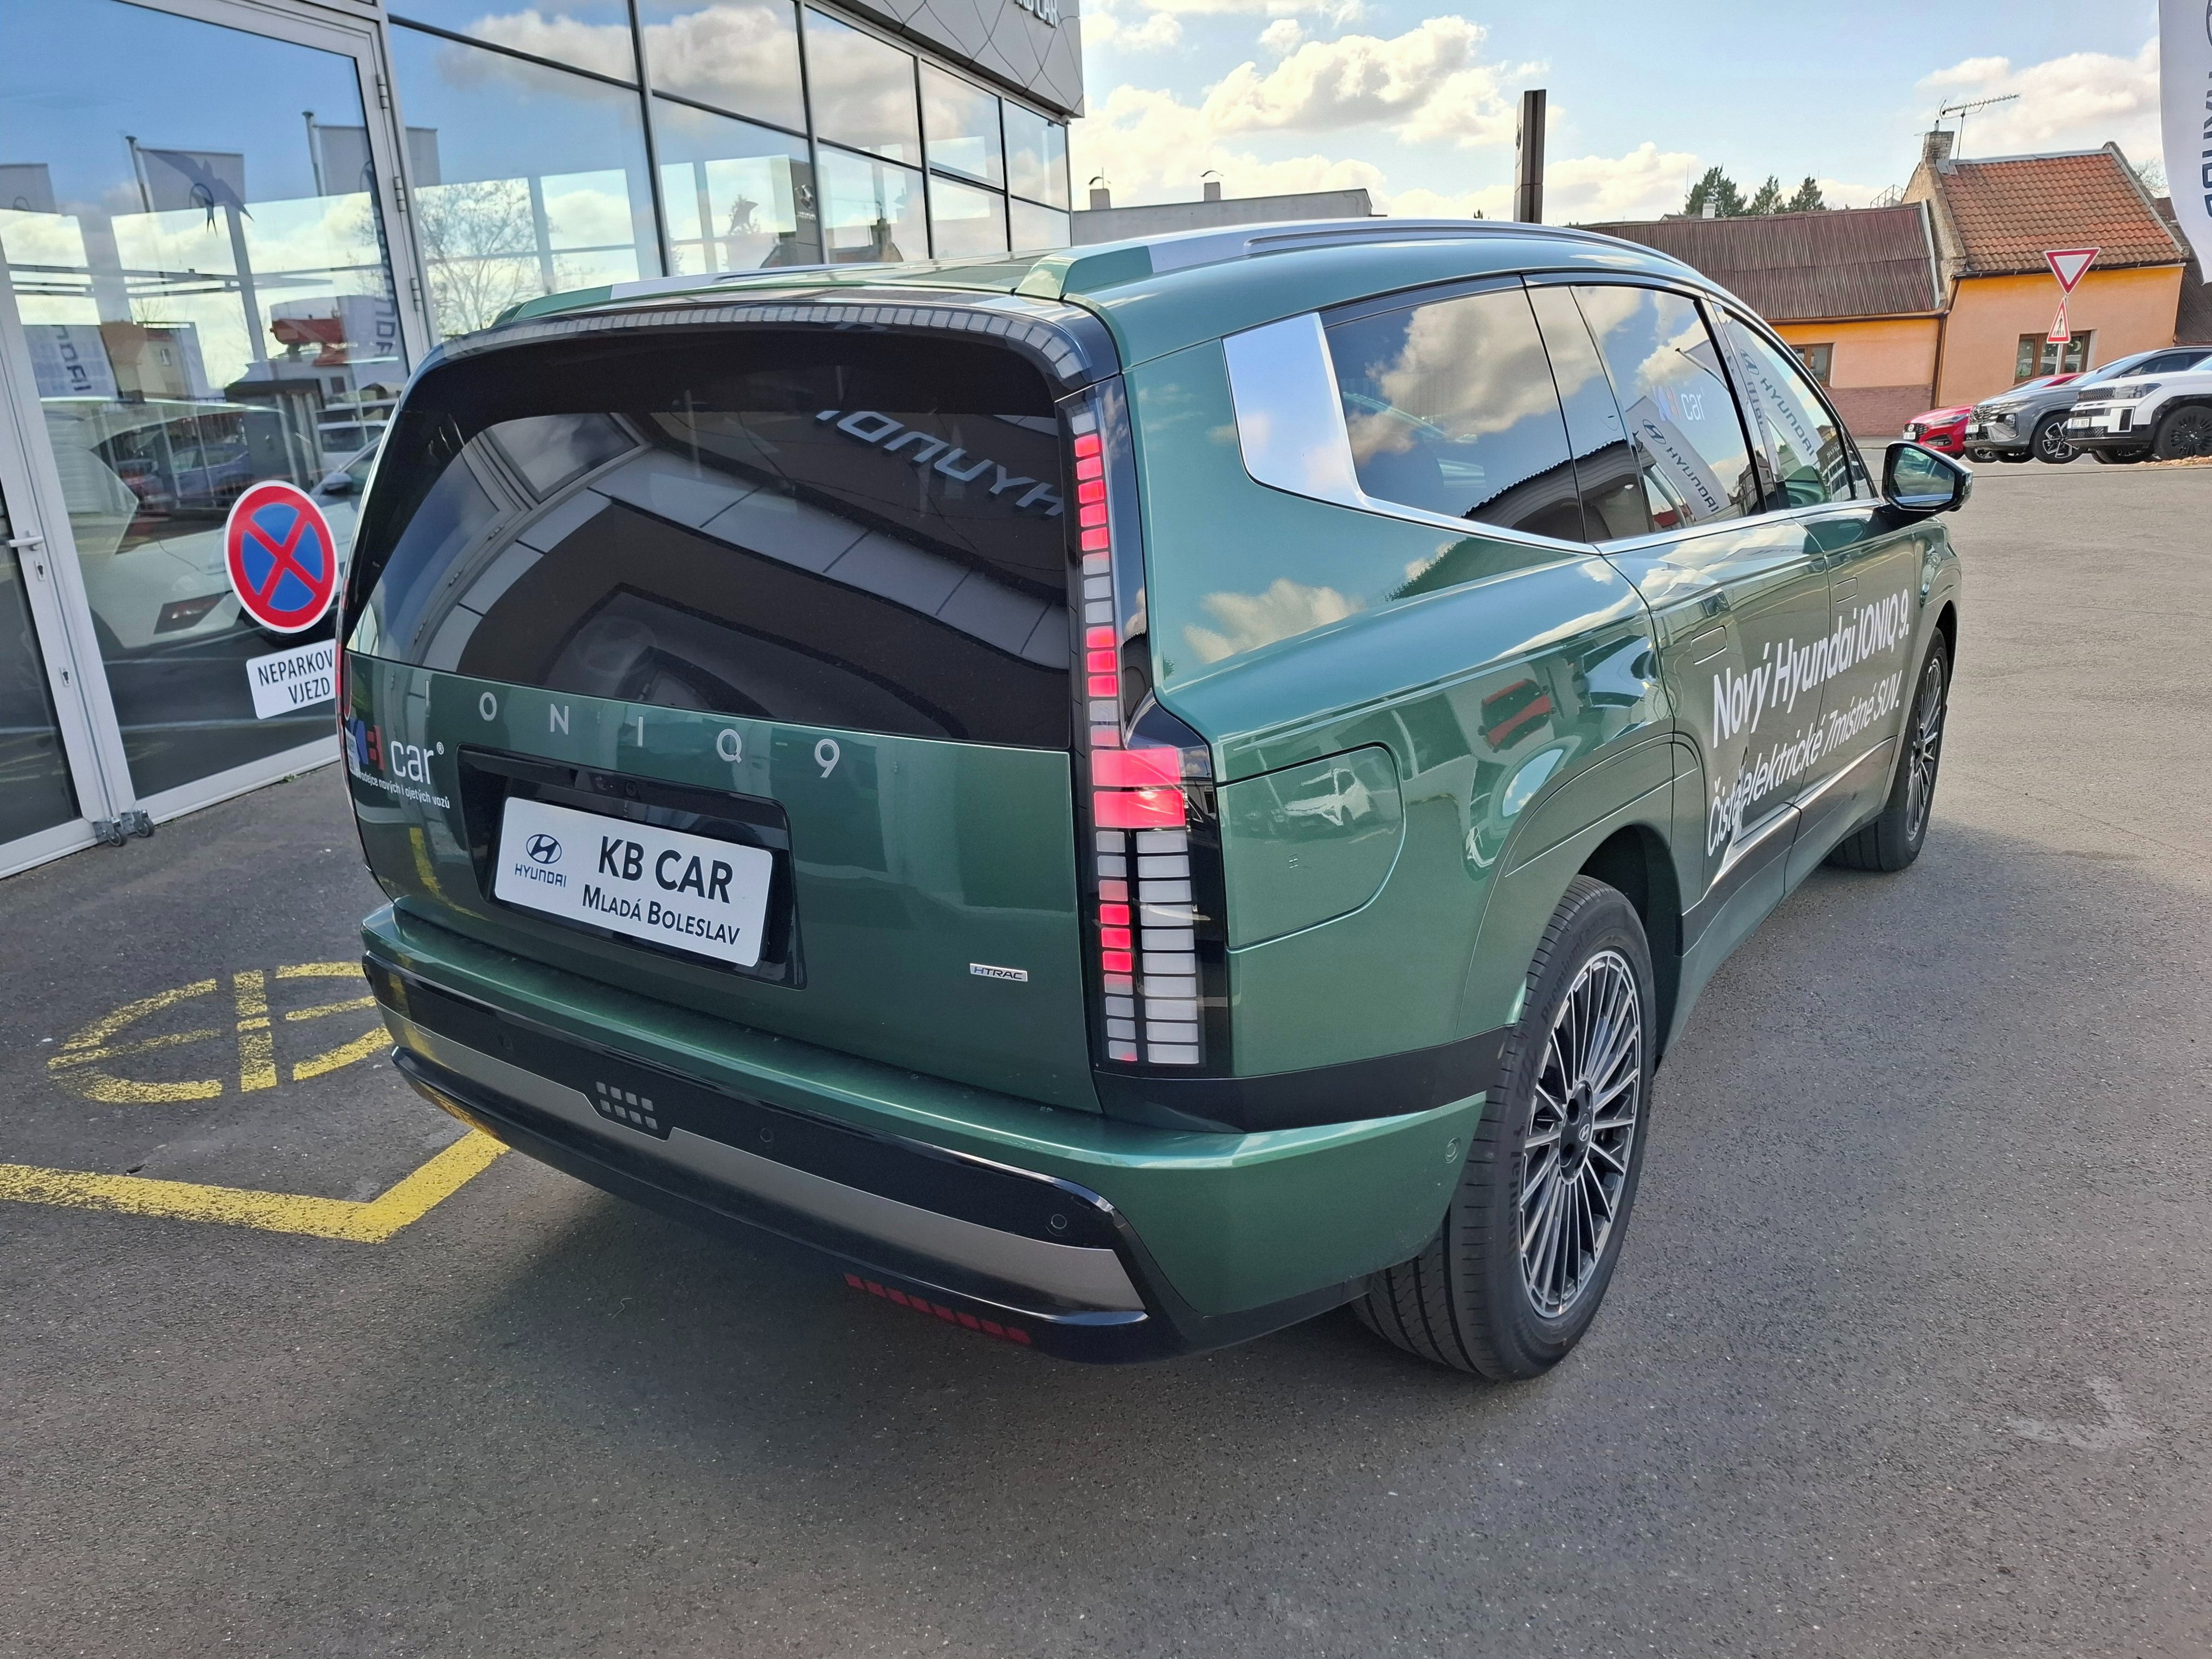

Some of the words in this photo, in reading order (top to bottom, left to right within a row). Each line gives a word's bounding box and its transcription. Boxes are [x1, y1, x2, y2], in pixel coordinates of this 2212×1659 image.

[1666, 446, 1719, 512] HYUNDAI
[287, 677, 331, 704] VJEZD
[1713, 642, 1772, 749] Nový
[1771, 607, 1857, 714] Hyundai
[1855, 593, 1899, 664] IONIQ
[1822, 683, 1877, 757] 7místné
[1873, 670, 1902, 721] SUV.
[813, 738, 840, 779] 9
[379, 779, 401, 794] nových
[405, 787, 432, 803] ojetých
[432, 796, 451, 809] vozů
[515, 863, 567, 888] HYUNDAI
[598, 835, 645, 882] KB
[654, 848, 734, 904] CAR
[974, 967, 1023, 980] HTRAC
